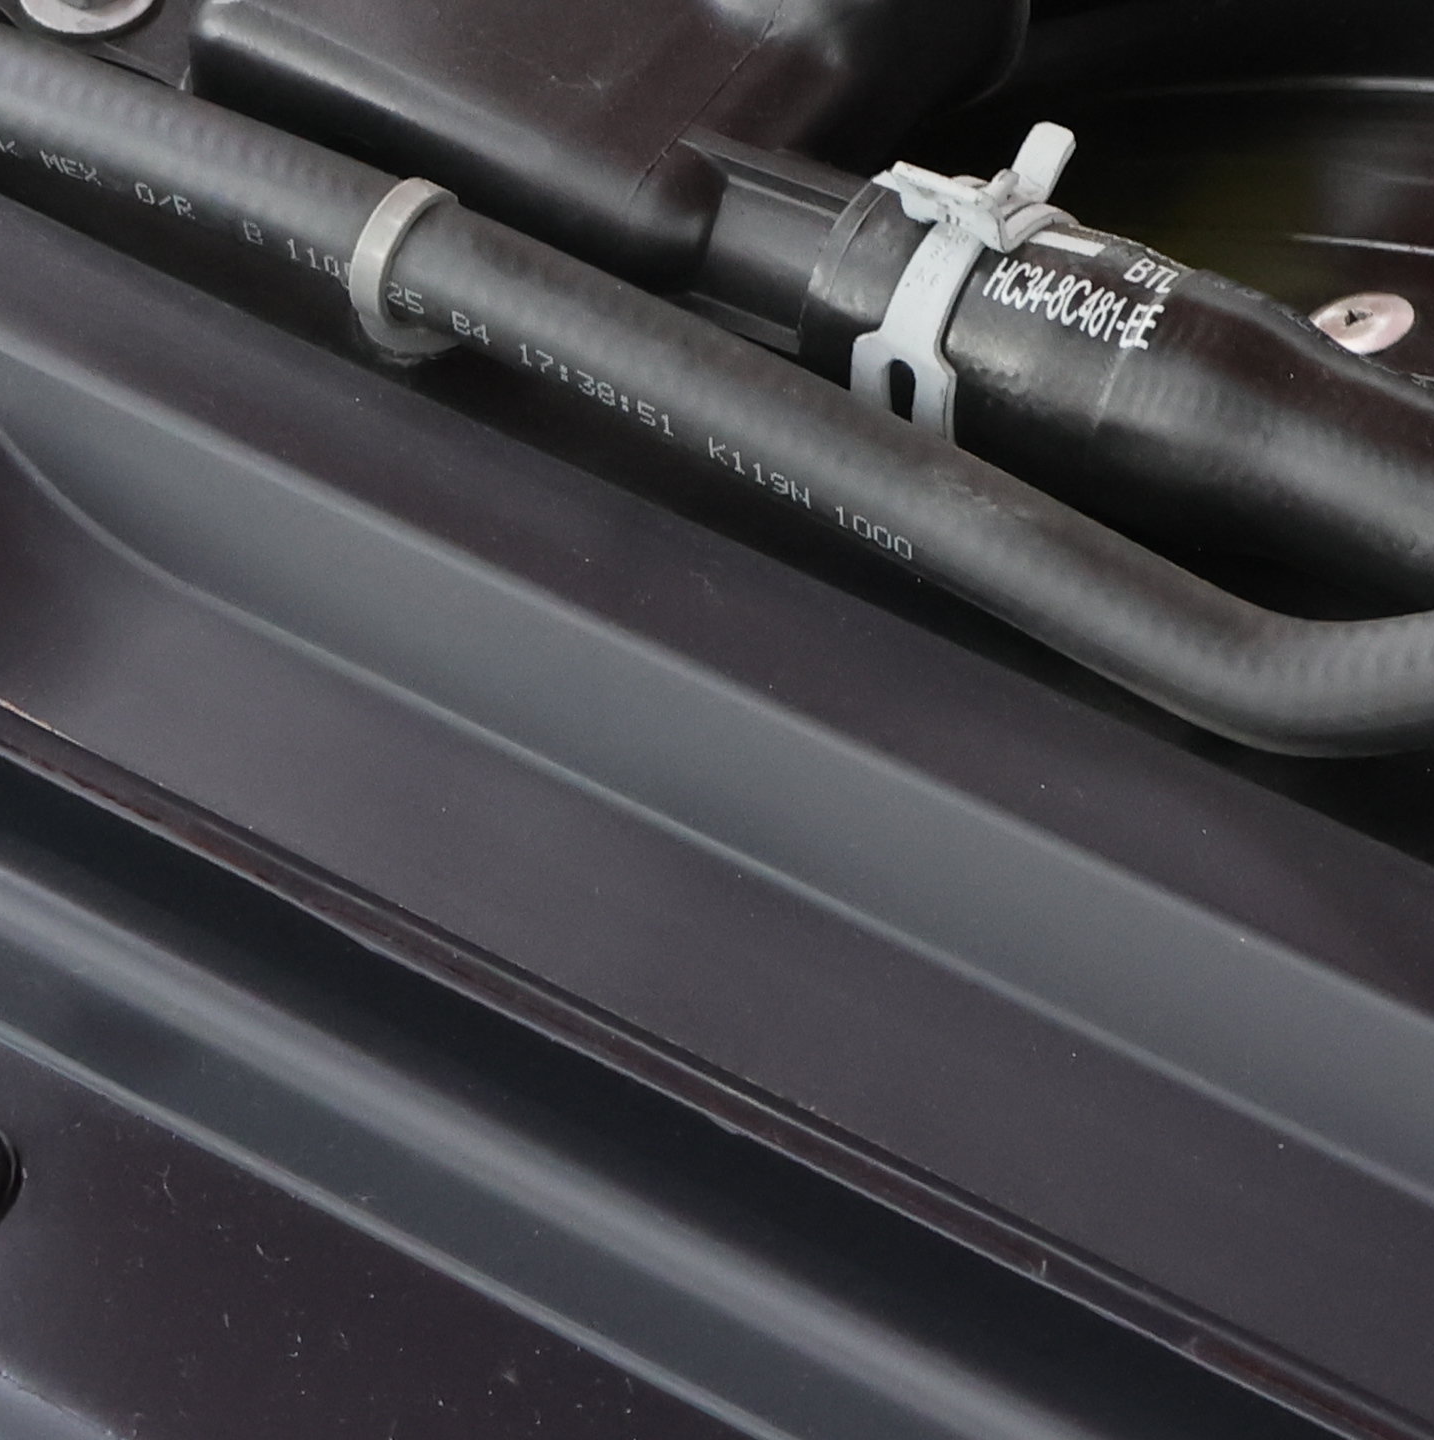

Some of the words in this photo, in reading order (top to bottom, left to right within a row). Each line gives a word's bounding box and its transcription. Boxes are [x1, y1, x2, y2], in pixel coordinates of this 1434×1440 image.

[39, 149, 103, 188] MEX
[451, 311, 491, 346] B4
[518, 342, 675, 438] 17:38:51
[707, 435, 812, 510] K119N
[834, 504, 914, 562] 1000
[981, 256, 1165, 351] HC34-8C481-EE
